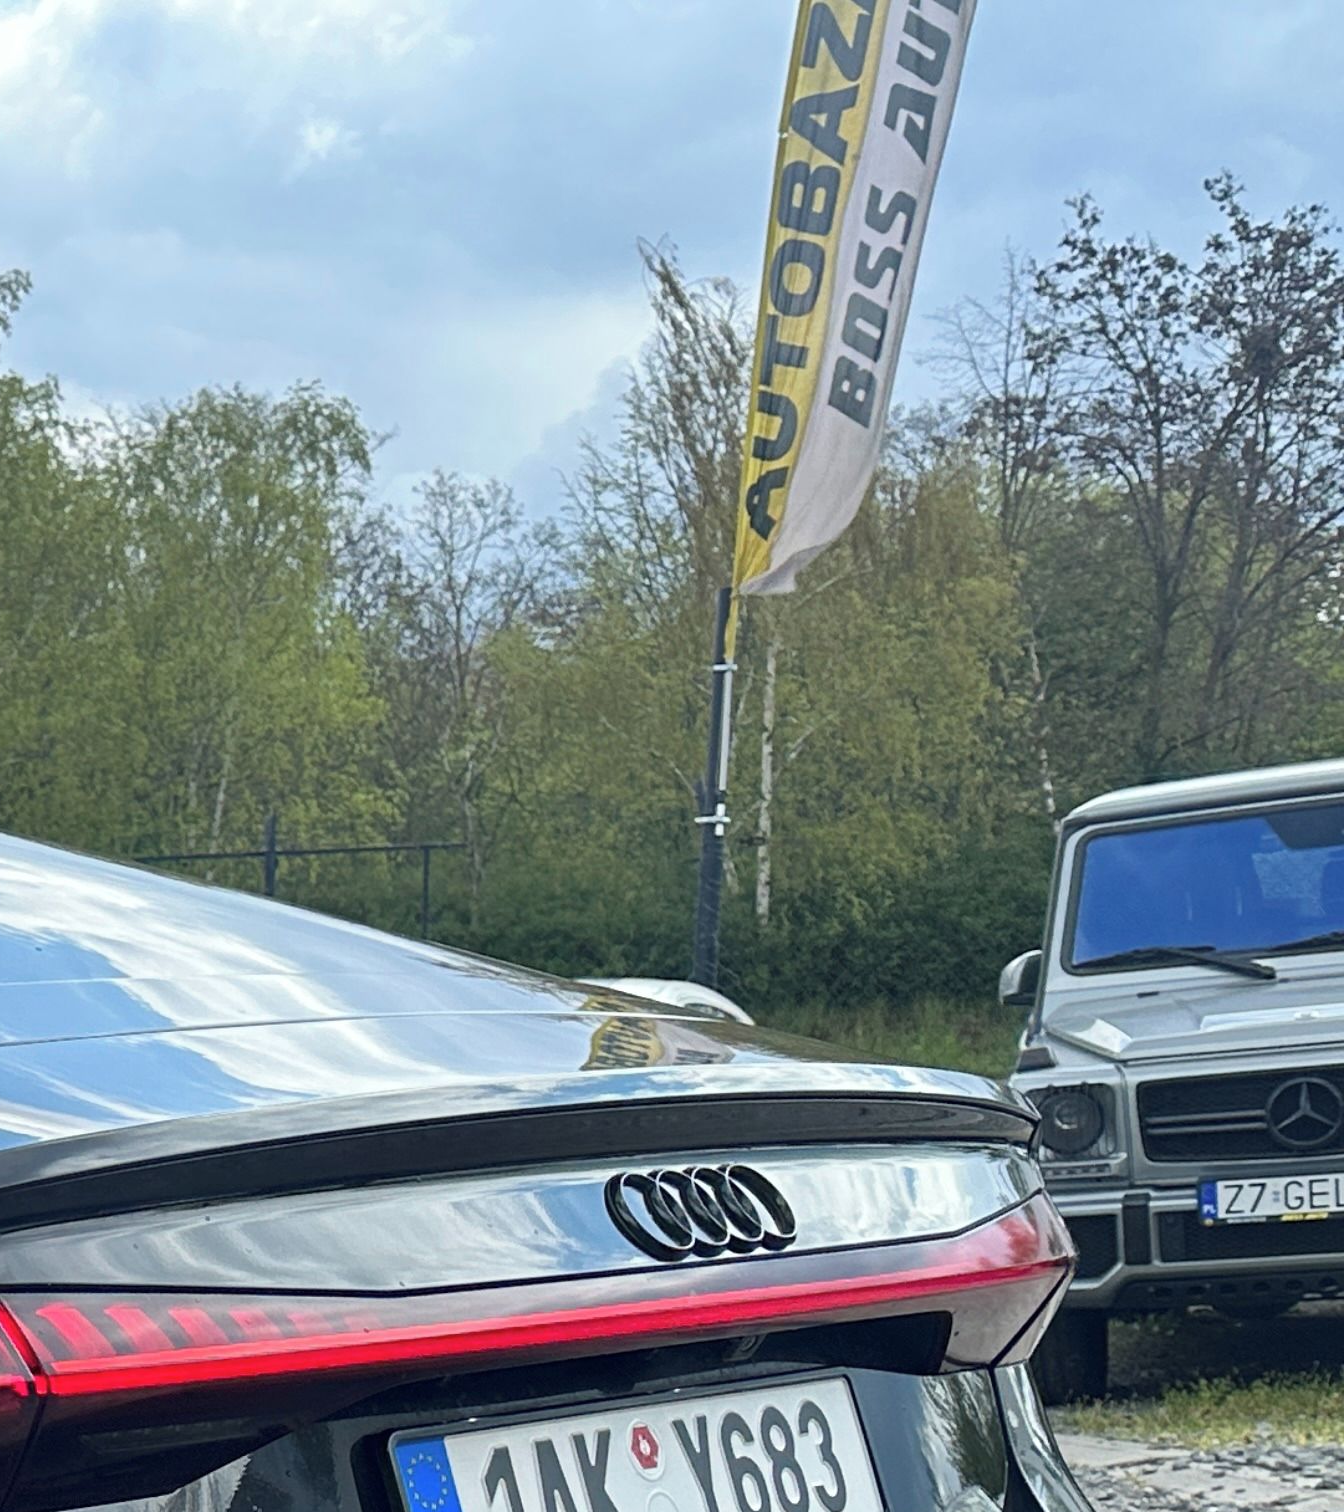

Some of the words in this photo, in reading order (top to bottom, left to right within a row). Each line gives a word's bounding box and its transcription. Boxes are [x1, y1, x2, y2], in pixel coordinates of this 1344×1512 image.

[747, 0, 875, 540] AUTOBAZ
[828, 184, 917, 430] BOSS
[1224, 1182, 1268, 1215] Z7
